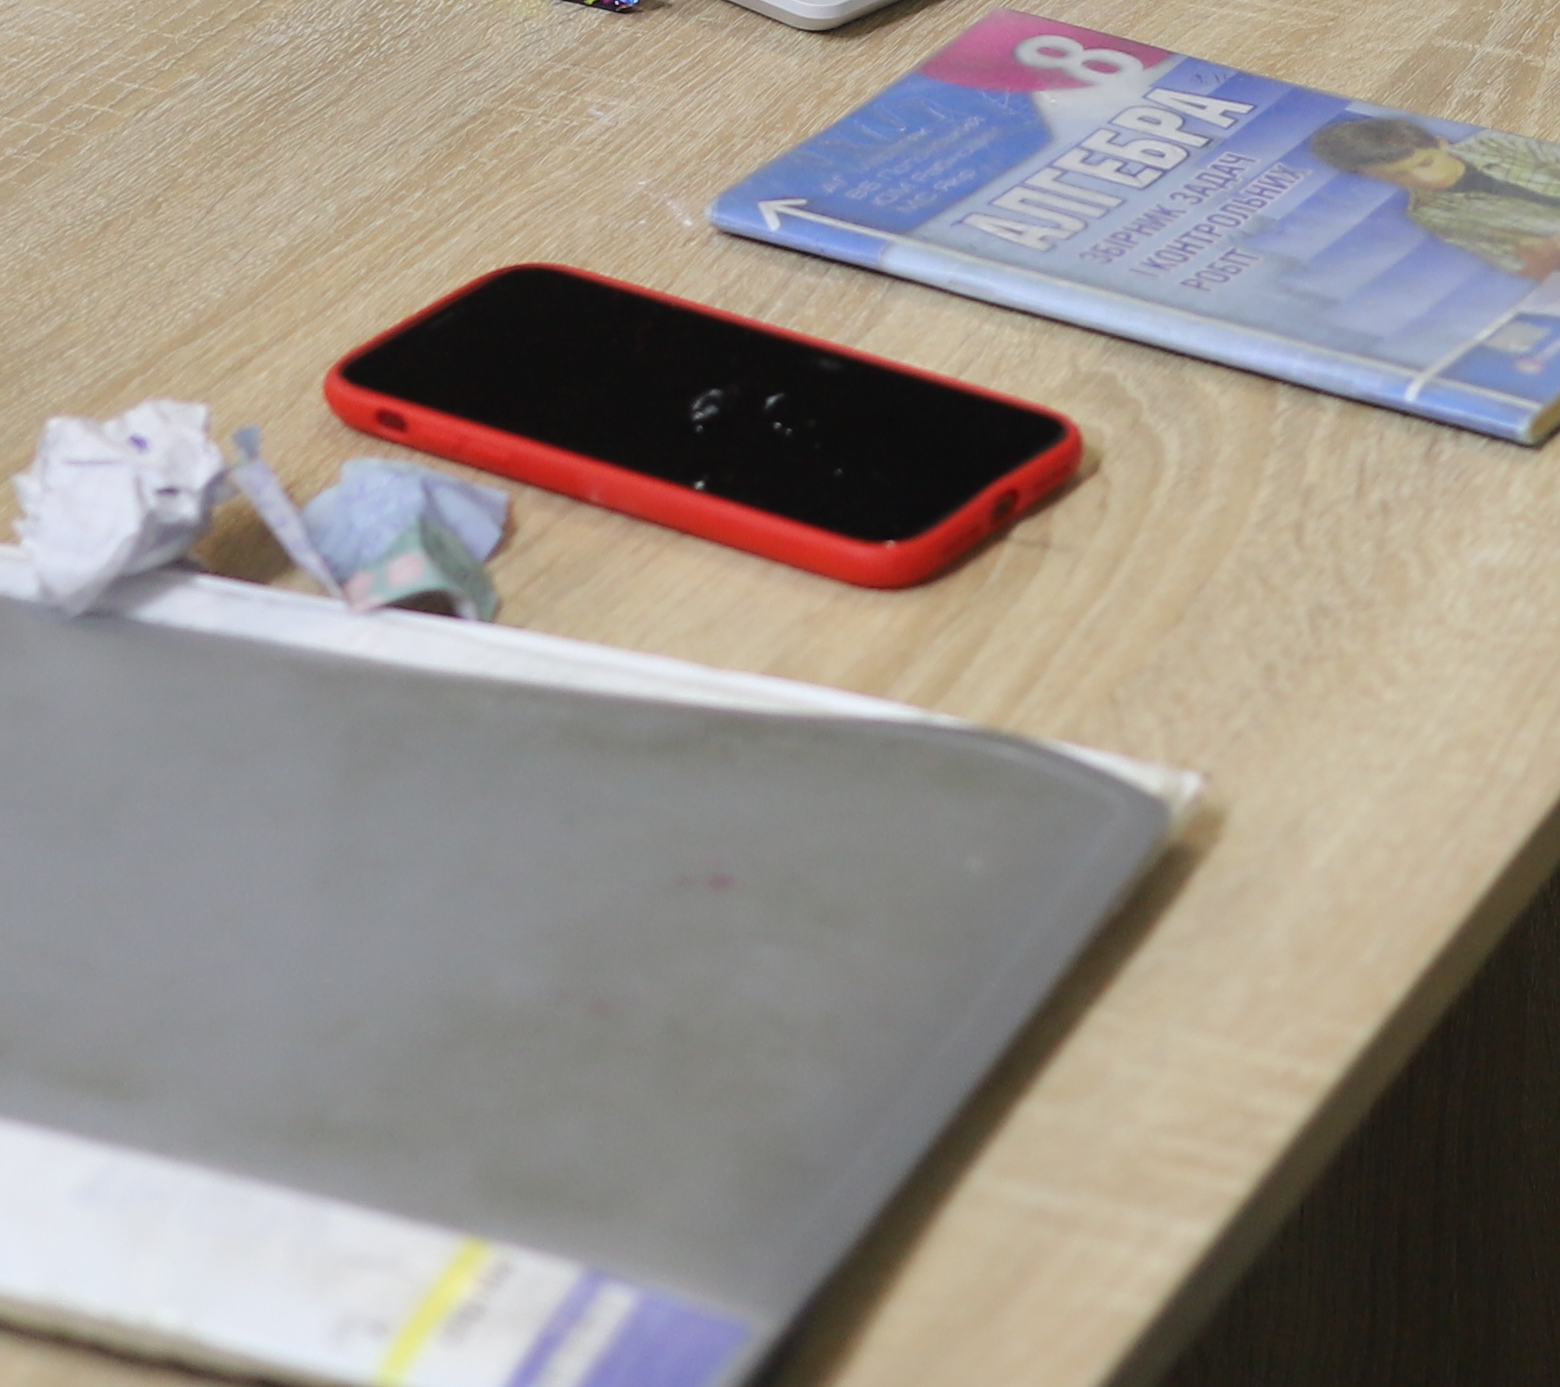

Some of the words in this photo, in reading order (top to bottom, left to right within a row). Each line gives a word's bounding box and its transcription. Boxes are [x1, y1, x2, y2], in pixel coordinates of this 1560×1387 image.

[1010, 35, 1142, 84] 8
[955, 85, 1260, 252] АЛГЕБРА
[1076, 203, 1189, 266] ЗБІРНИК
[1165, 151, 1262, 206] ЗАДАЧ
[1140, 161, 1311, 272] КОНТРОЛЬНИХ
[1178, 246, 1264, 293] РОБІТ
